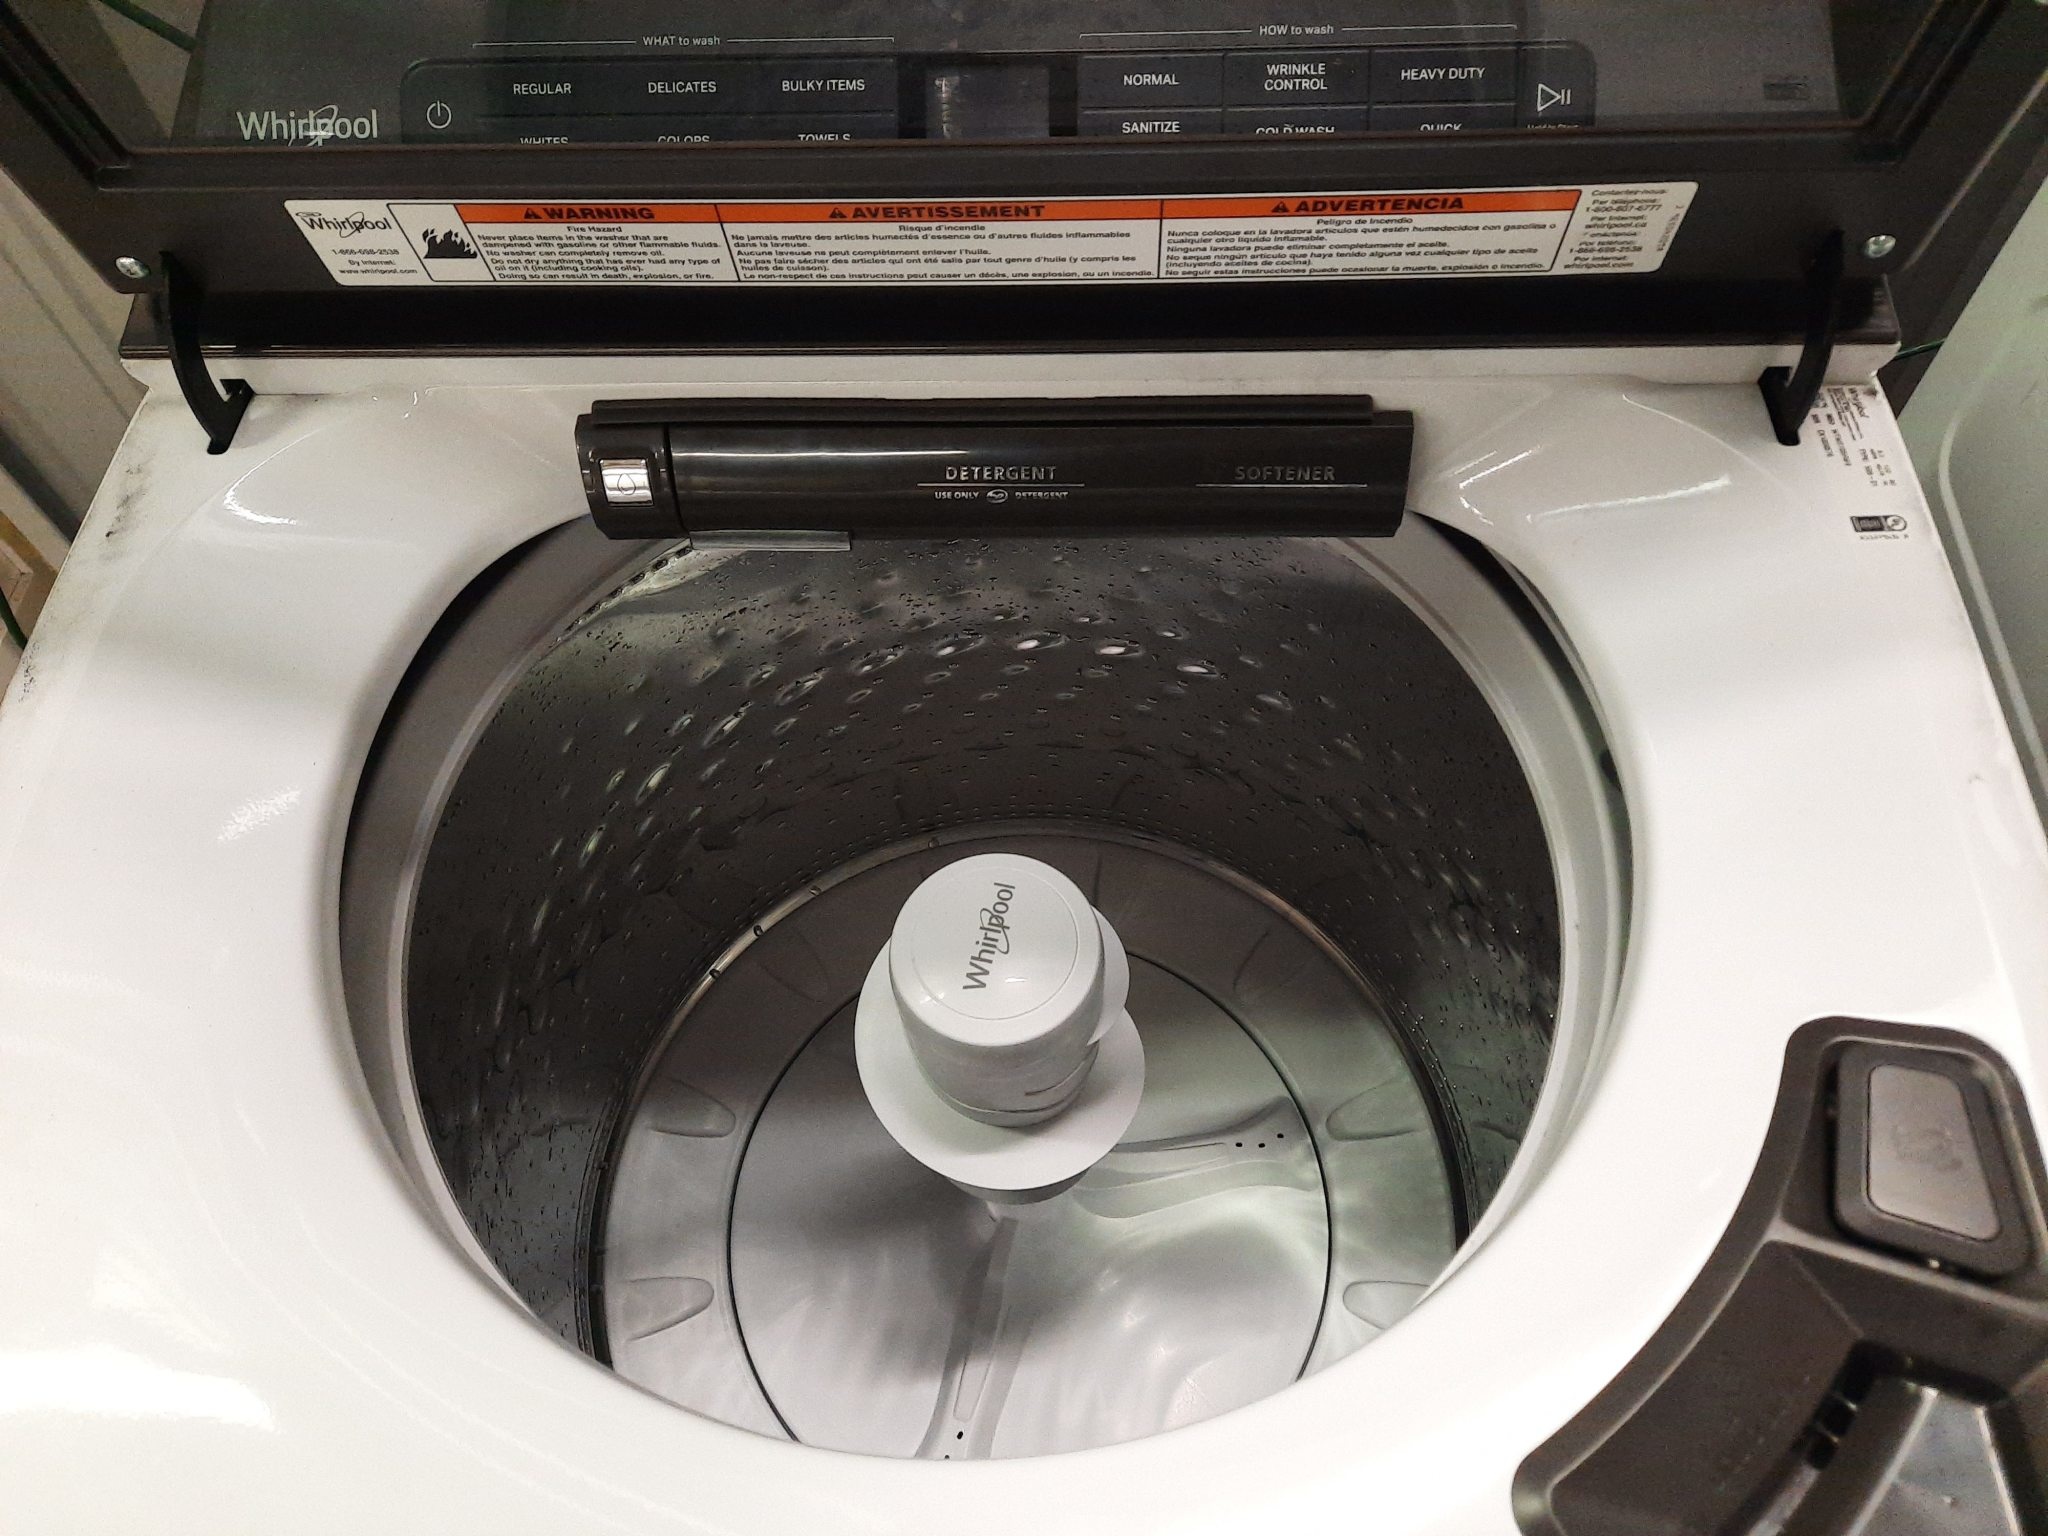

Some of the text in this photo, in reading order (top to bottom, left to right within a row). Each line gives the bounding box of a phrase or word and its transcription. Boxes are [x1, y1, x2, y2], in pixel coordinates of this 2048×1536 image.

[1259, 24, 1334, 36] HOW to wash
[642, 35, 720, 46] WHAT to wash
[1266, 62, 1326, 76] WRINKLE
[1401, 67, 1486, 81] HEAVY DUTY
[782, 78, 866, 92] BULKY ITEMS
[1123, 74, 1180, 86] NORMAL
[1264, 78, 1328, 91] CONTROL
[513, 82, 572, 95] REGULAR
[648, 81, 717, 94] DELICATES
[236, 104, 378, 147] Whirlpool
[1122, 120, 1181, 134] SANITIZE
[1294, 197, 1464, 213] ADVERTENCIA
[542, 207, 655, 220] WARNING
[852, 206, 1045, 218] AVERTISSEMENT
[300, 212, 392, 238] Whirlpool
[898, 224, 932, 232] Risque
[946, 466, 1057, 481] DETERGENT
[1234, 466, 1336, 481] SOFTENER
[934, 492, 1069, 500] USE ONLY DETERGENT
[962, 882, 1016, 990] Whirlpool
